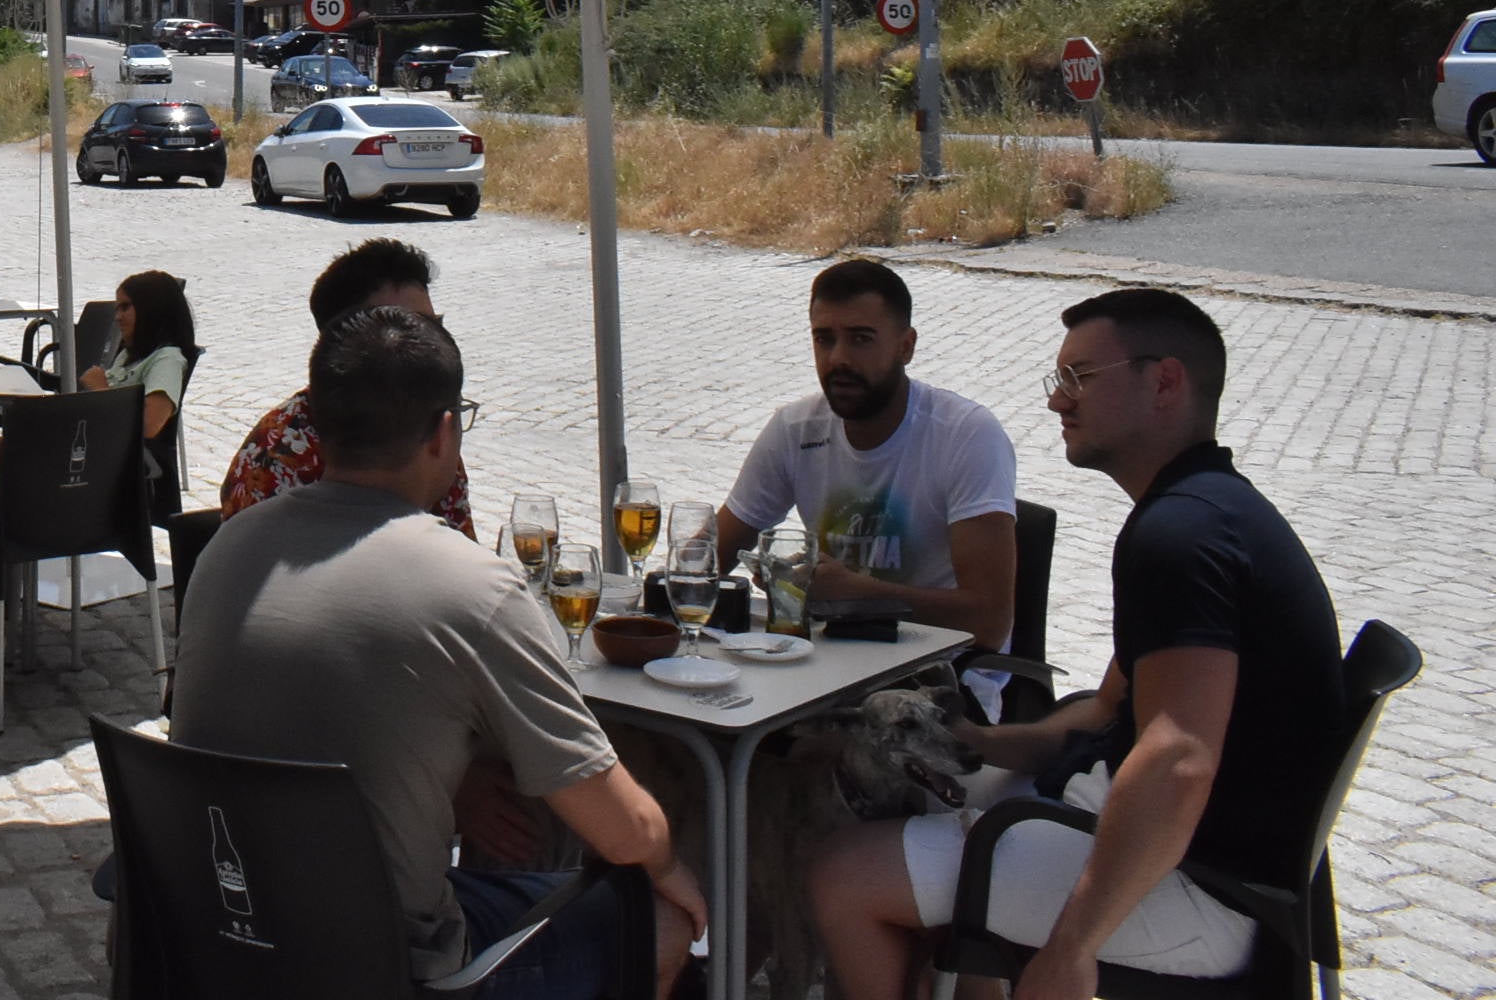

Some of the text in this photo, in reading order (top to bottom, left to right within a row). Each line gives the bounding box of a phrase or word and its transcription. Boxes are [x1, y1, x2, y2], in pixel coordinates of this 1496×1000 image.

[317, 1, 340, 15] 50
[888, 4, 912, 19] 50
[1063, 57, 1097, 83] STOP
